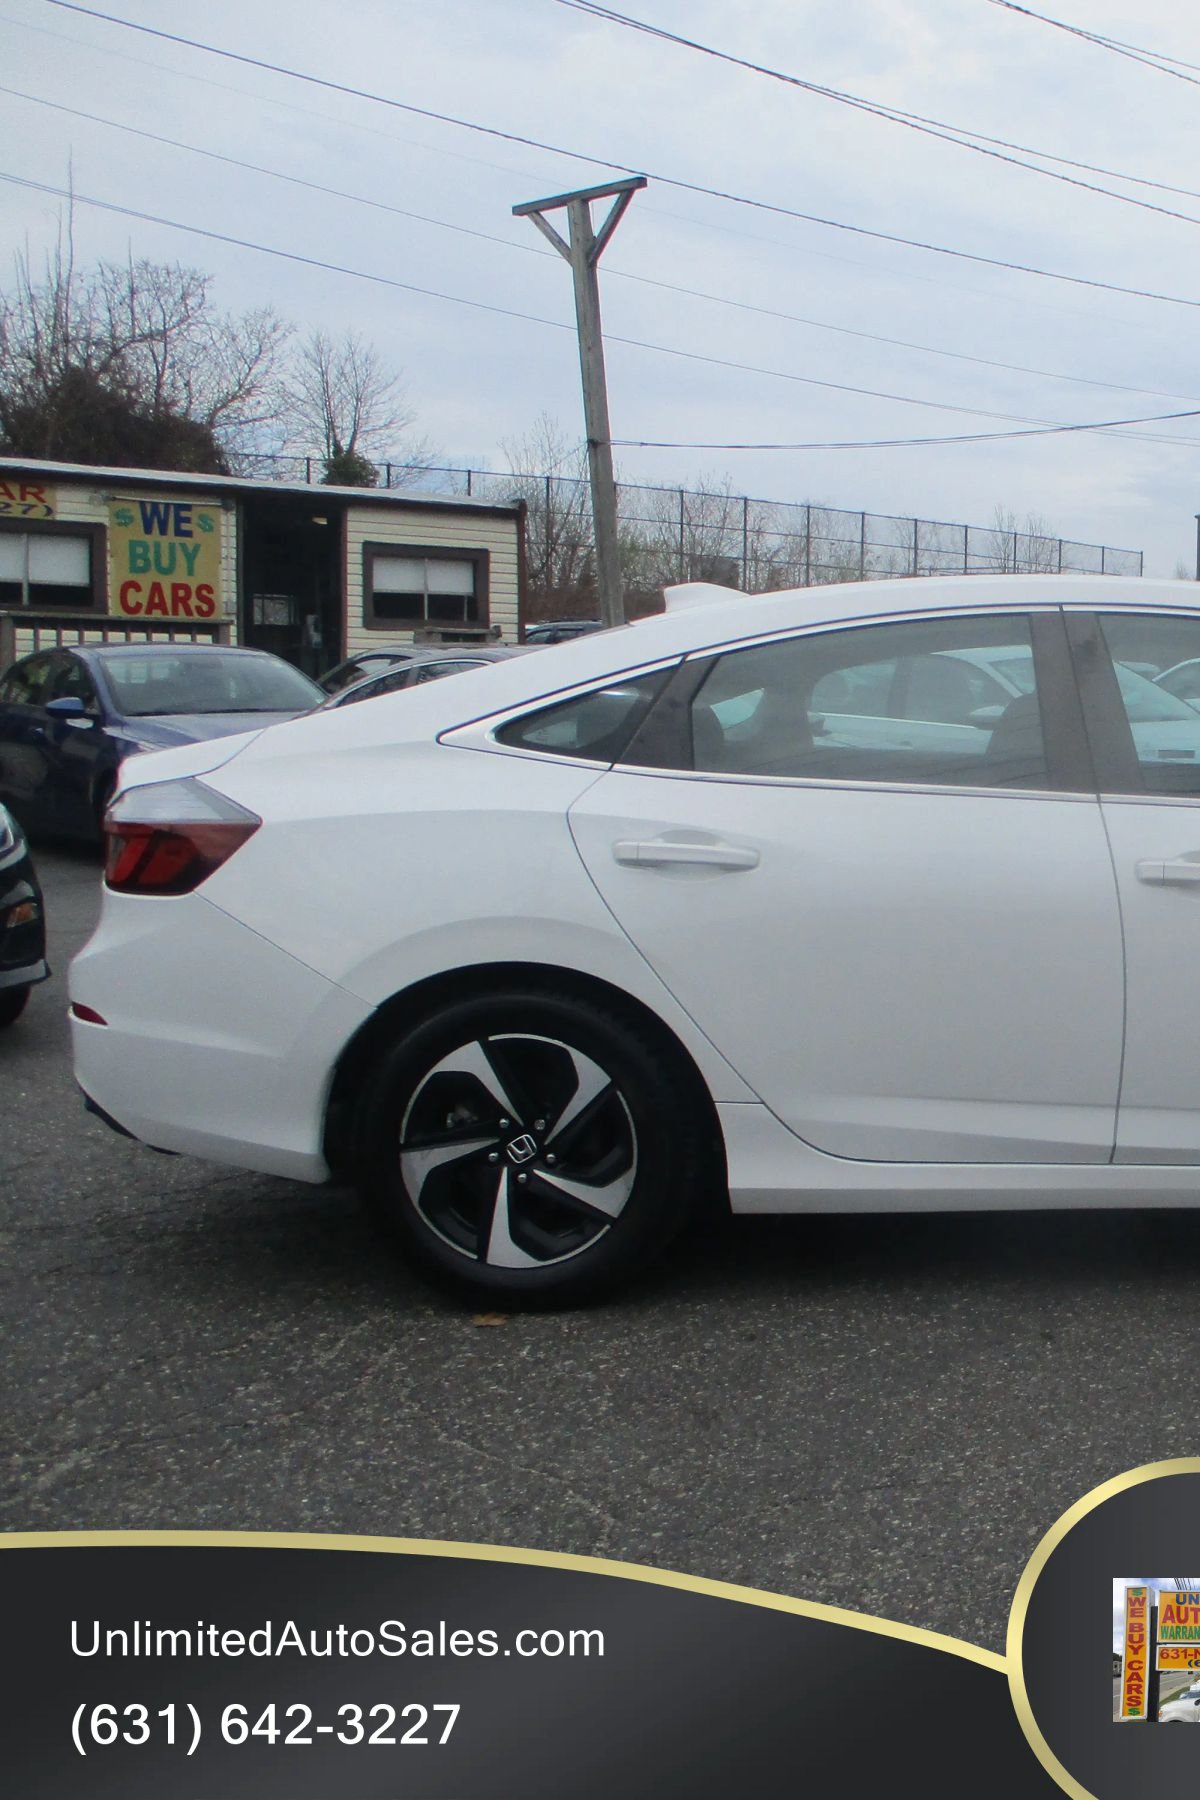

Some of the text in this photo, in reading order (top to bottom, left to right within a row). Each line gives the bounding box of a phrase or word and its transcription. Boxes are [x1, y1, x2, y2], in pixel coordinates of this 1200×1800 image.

[139, 500, 193, 538] WE
[128, 540, 201, 577] BUY
[120, 580, 216, 617] CARS
